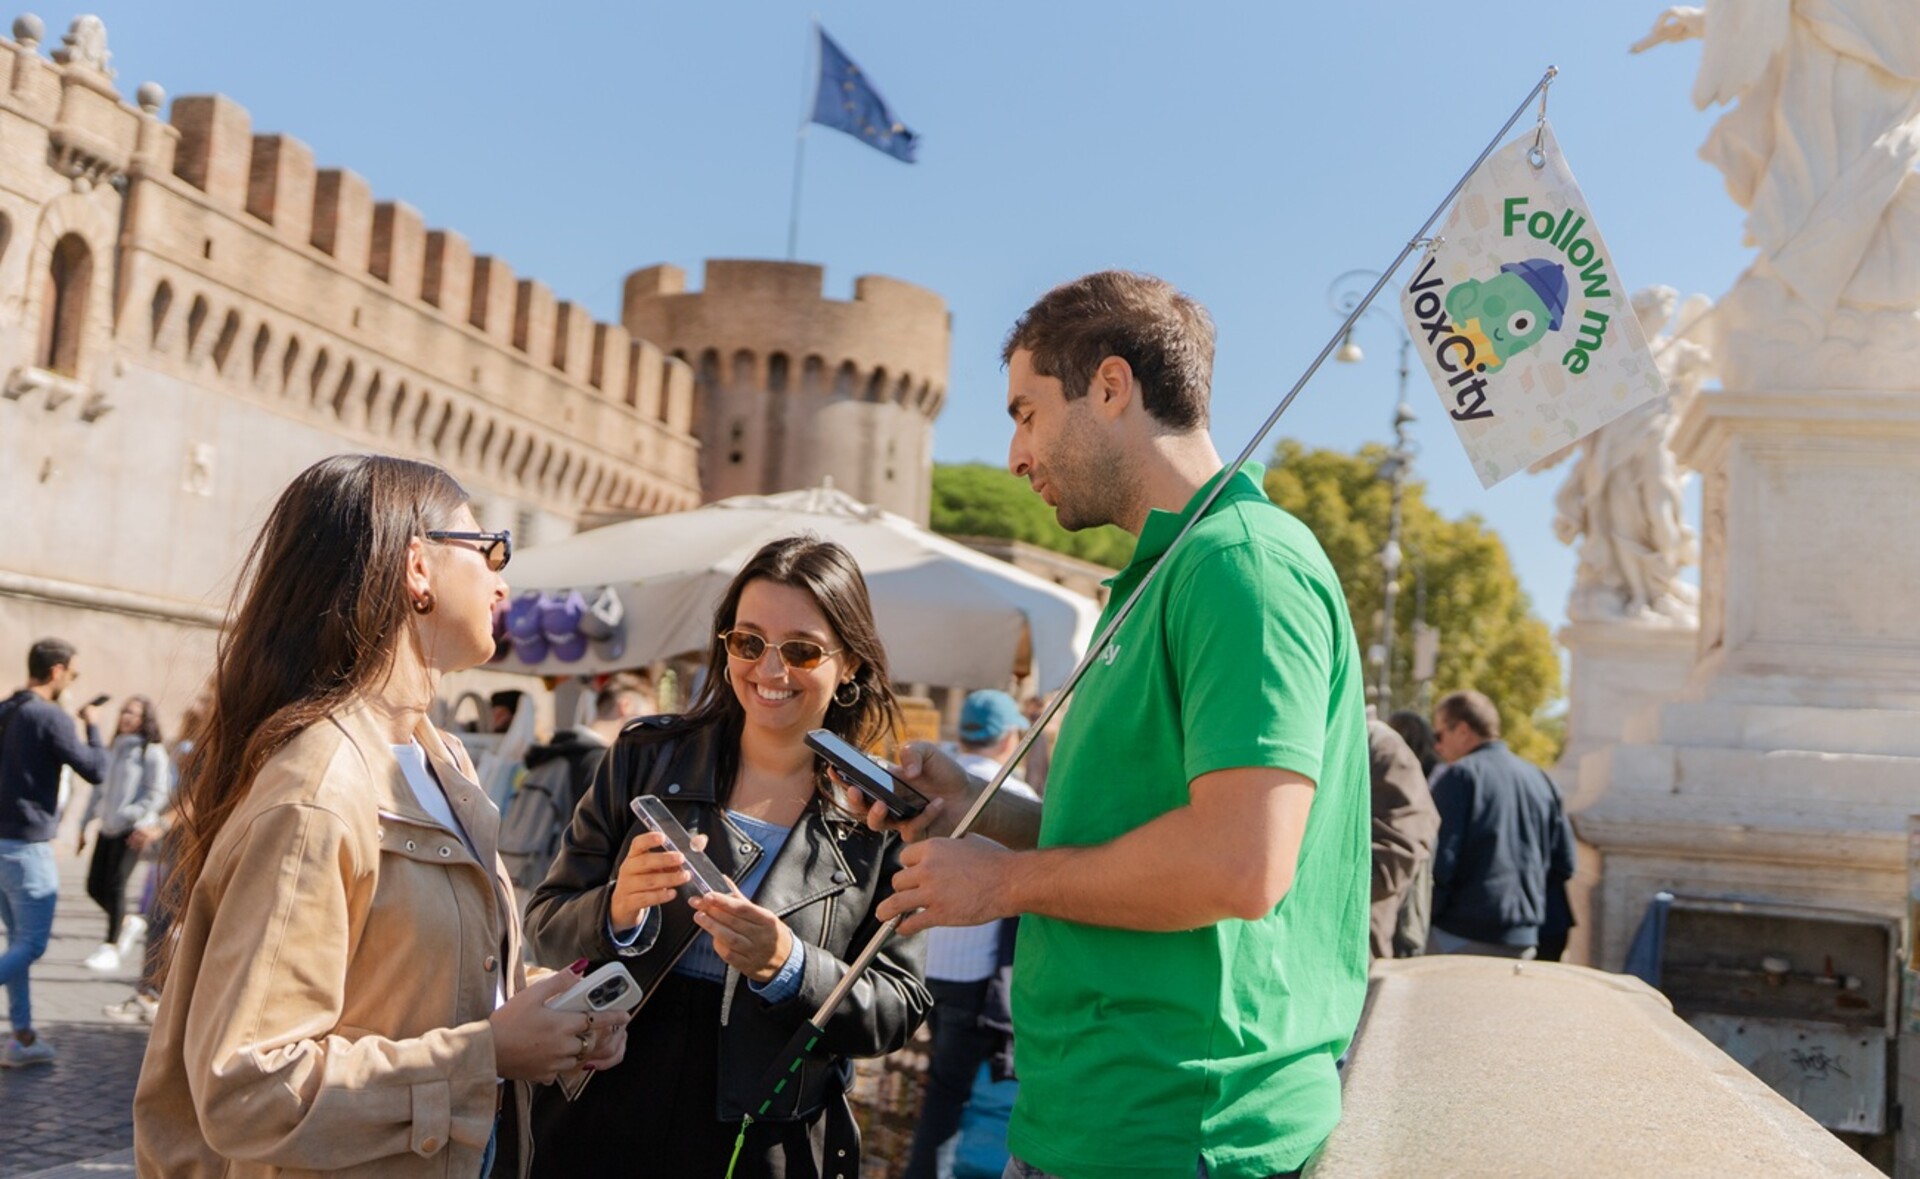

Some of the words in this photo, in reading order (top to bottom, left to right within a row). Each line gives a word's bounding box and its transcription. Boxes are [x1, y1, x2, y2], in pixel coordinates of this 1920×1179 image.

[1408, 256, 1495, 422] VoxCity
[1503, 197, 1612, 299] Follow
[1562, 309, 1611, 375] me
